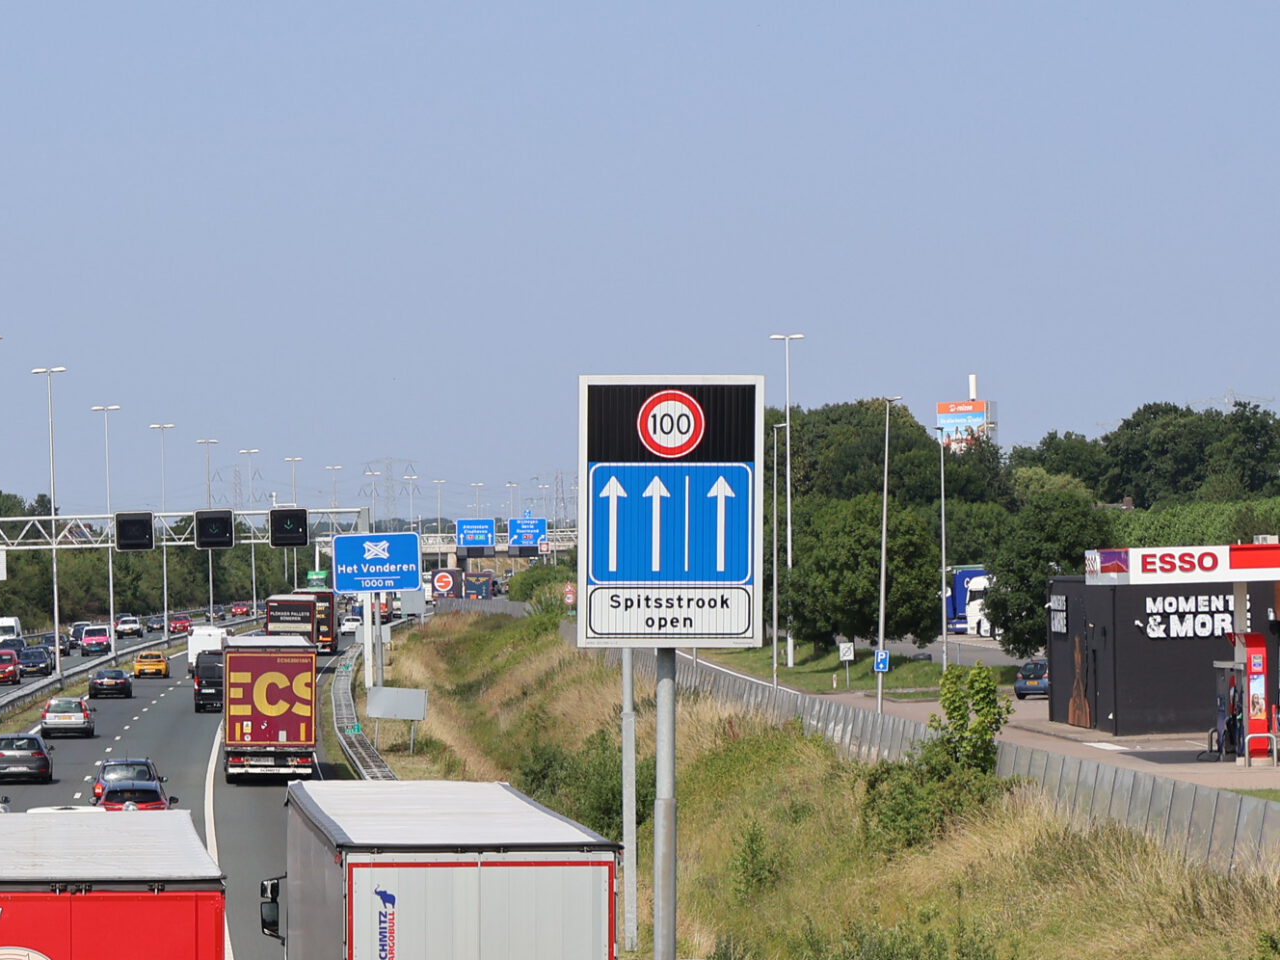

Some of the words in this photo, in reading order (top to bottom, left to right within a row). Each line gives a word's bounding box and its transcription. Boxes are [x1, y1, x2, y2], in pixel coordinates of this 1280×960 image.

[650, 413, 691, 435] 100
[337, 563, 358, 573] Het
[361, 562, 417, 573] Vonderen
[1141, 552, 1219, 573] ESSO
[609, 594, 730, 611] Spitsstrook
[645, 617, 693, 630] open
[1146, 613, 1251, 638] &MOR
[877, 652, 886, 662] P
